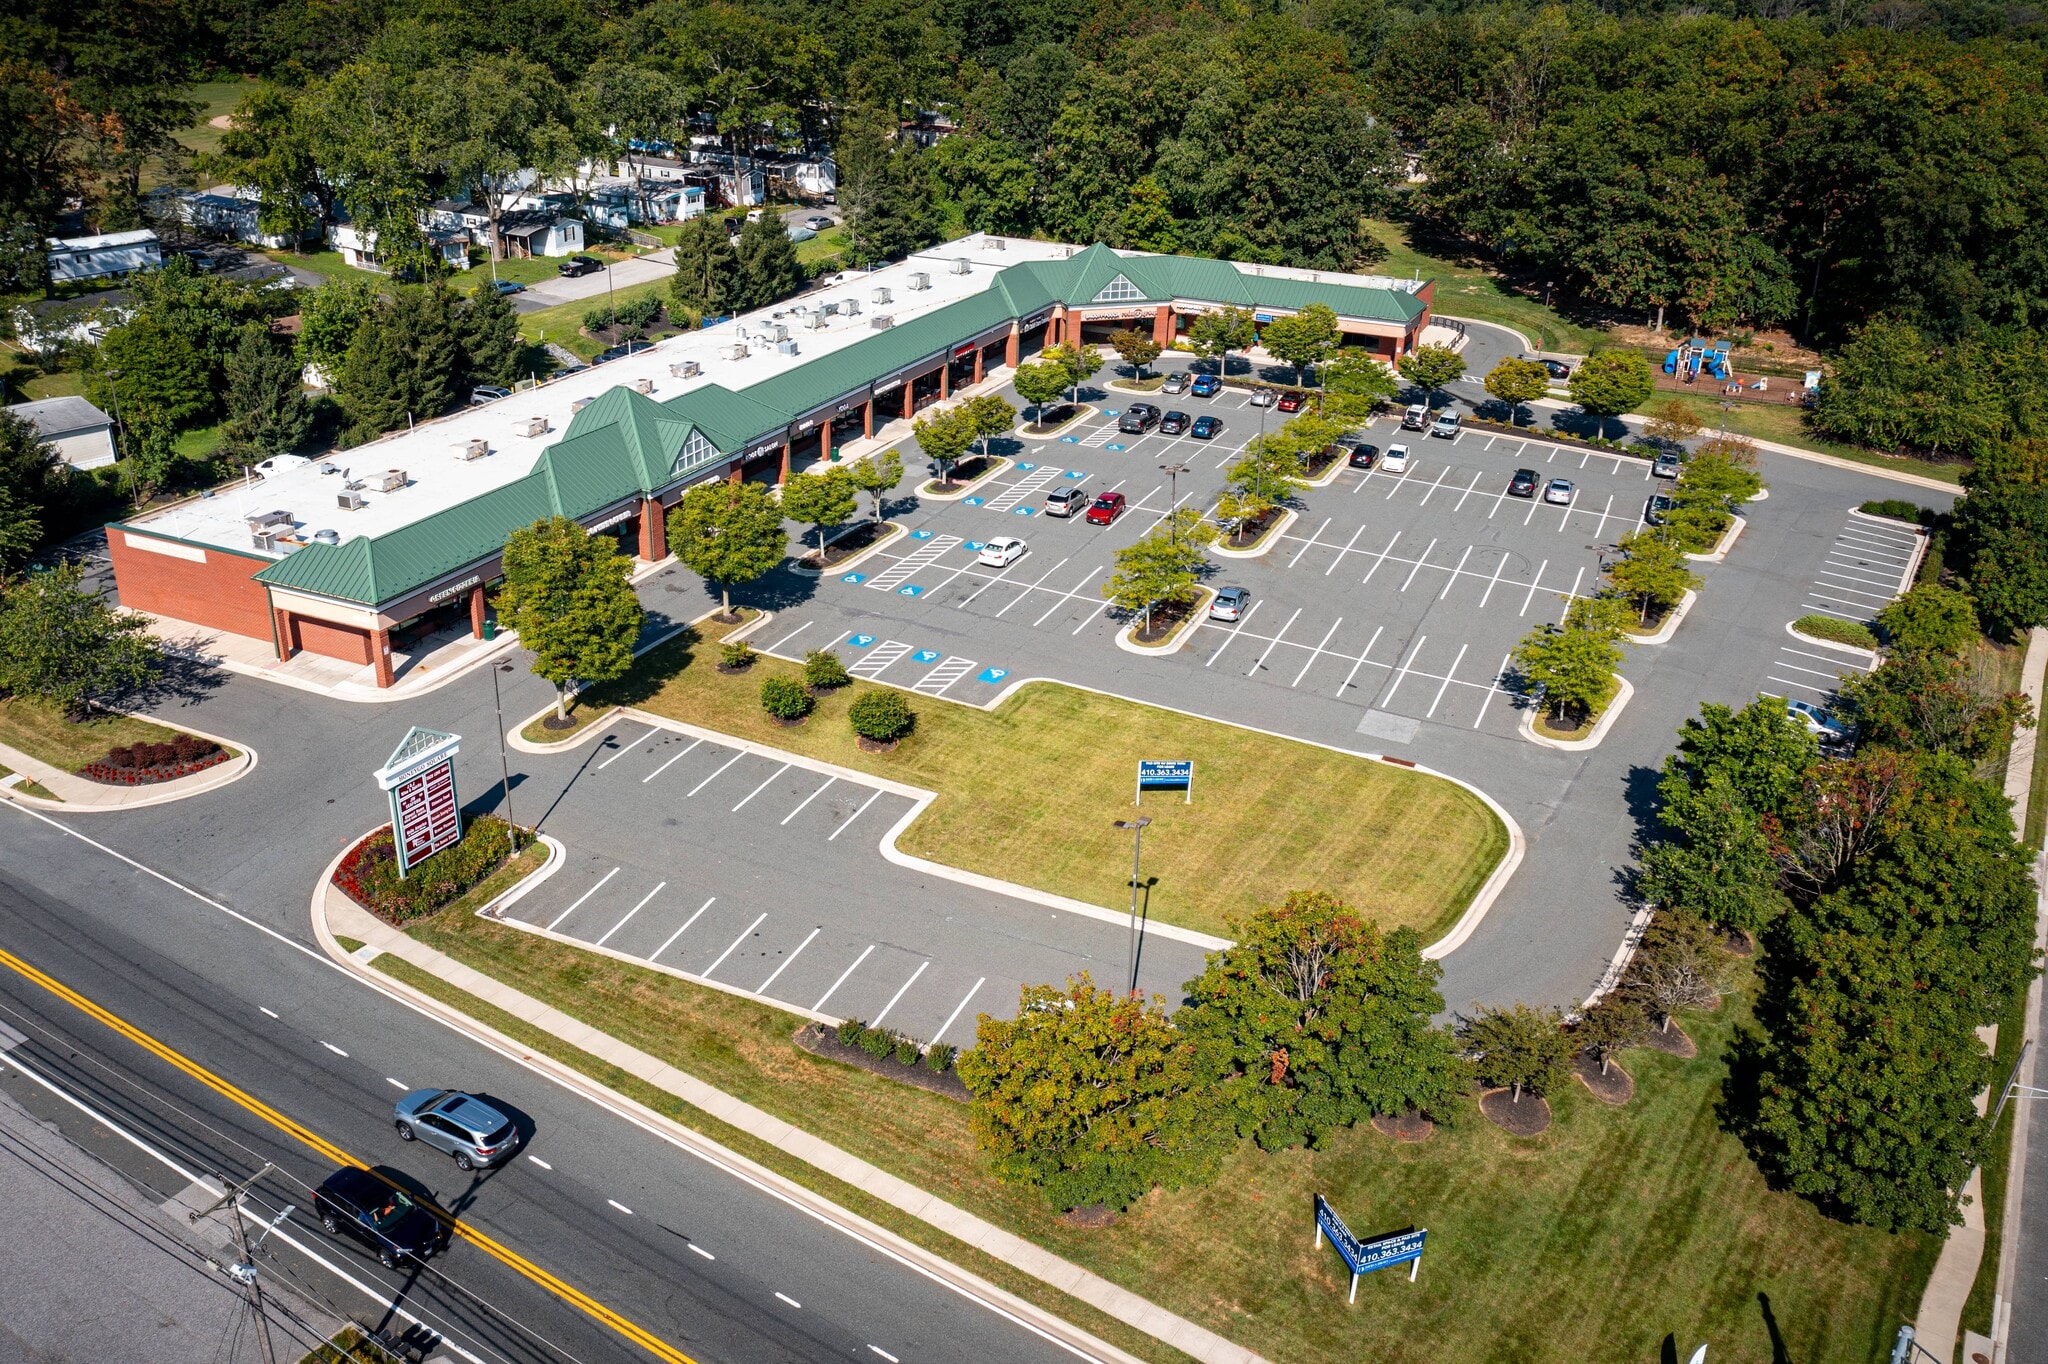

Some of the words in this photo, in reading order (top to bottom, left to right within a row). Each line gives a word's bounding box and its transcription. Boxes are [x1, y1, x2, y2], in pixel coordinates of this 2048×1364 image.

[399, 765, 425, 781] HONEYGO
[427, 752, 448, 766] SQUARE
[1361, 1241, 1422, 1263] 410.363.3434
